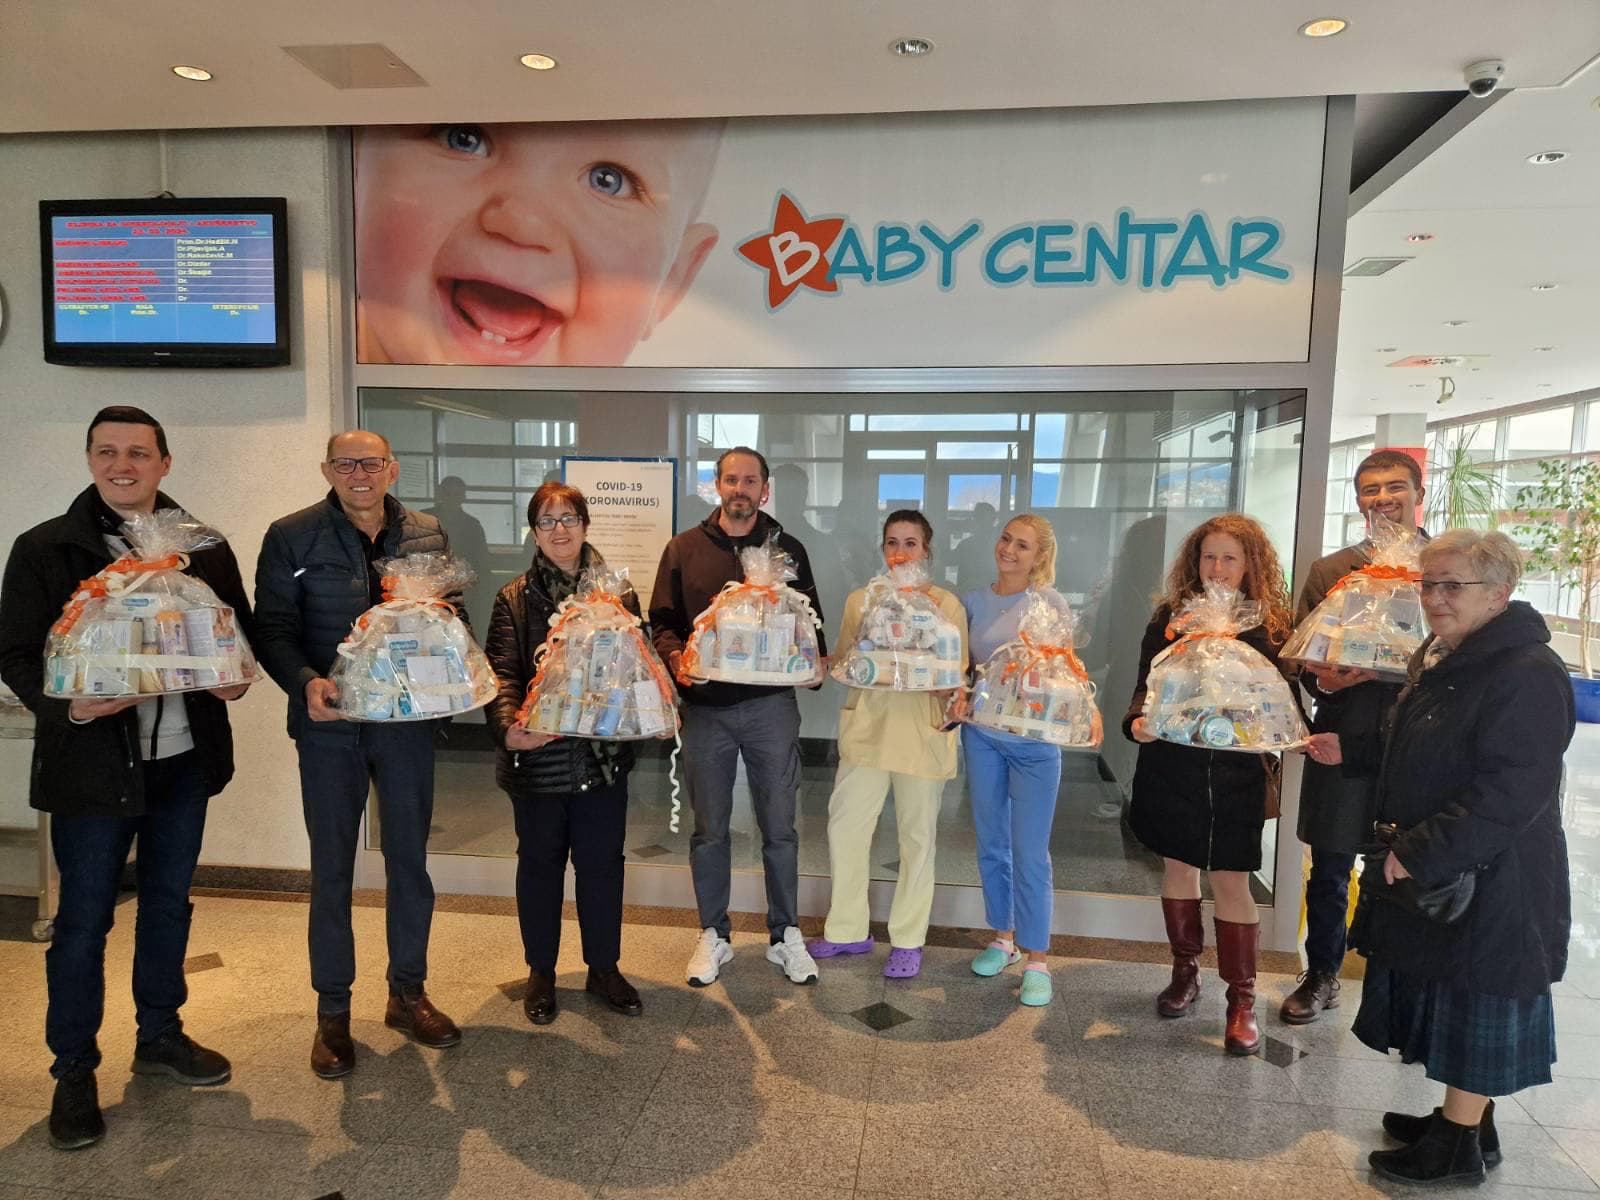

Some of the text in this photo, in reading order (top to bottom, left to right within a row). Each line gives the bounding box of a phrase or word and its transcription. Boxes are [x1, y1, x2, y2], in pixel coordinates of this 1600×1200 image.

[769, 210, 1290, 288] BABY CENTAR
[596, 481, 643, 491] COVID-19
[583, 496, 660, 508] KORONAVIRUS)
